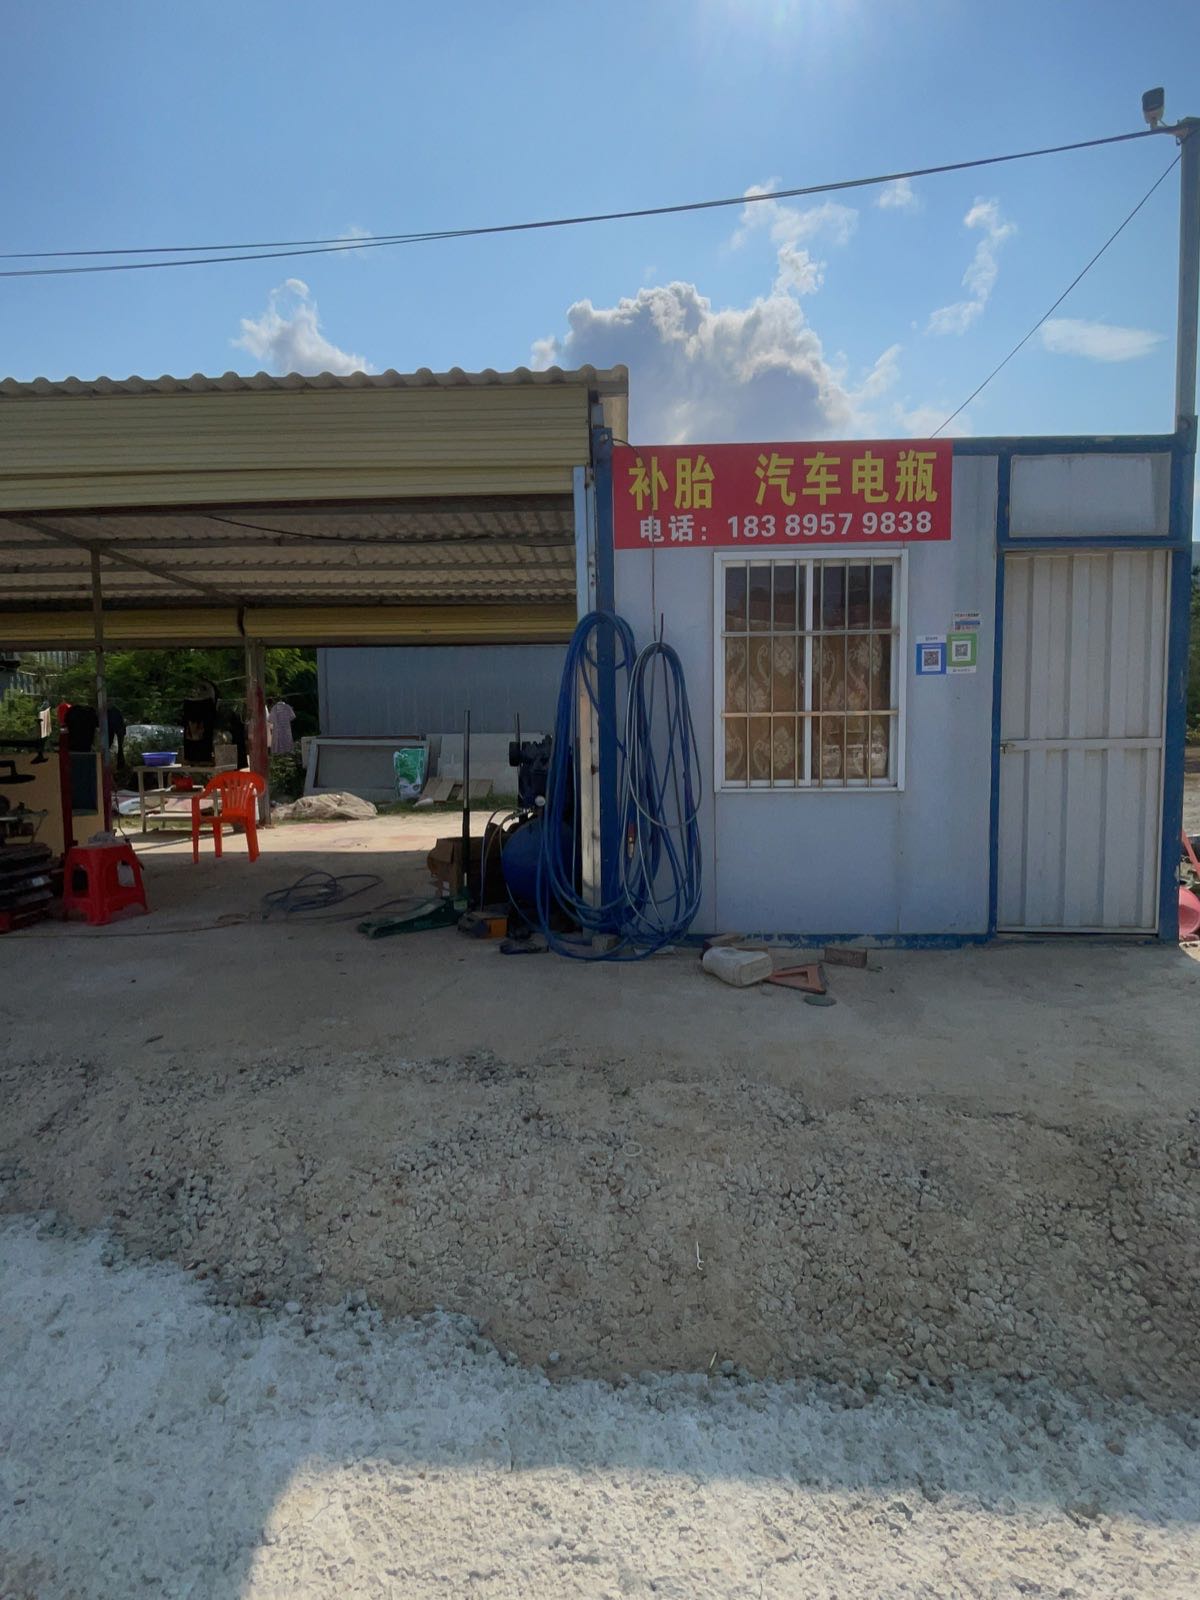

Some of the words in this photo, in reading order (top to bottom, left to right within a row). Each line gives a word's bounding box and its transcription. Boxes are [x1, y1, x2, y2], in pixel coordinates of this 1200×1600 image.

[628, 455, 715, 511] 补胎
[755, 450, 938, 507] 汽车电瓶
[727, 515, 776, 538] 183
[784, 512, 853, 536] 8957
[862, 511, 932, 534] 9838
